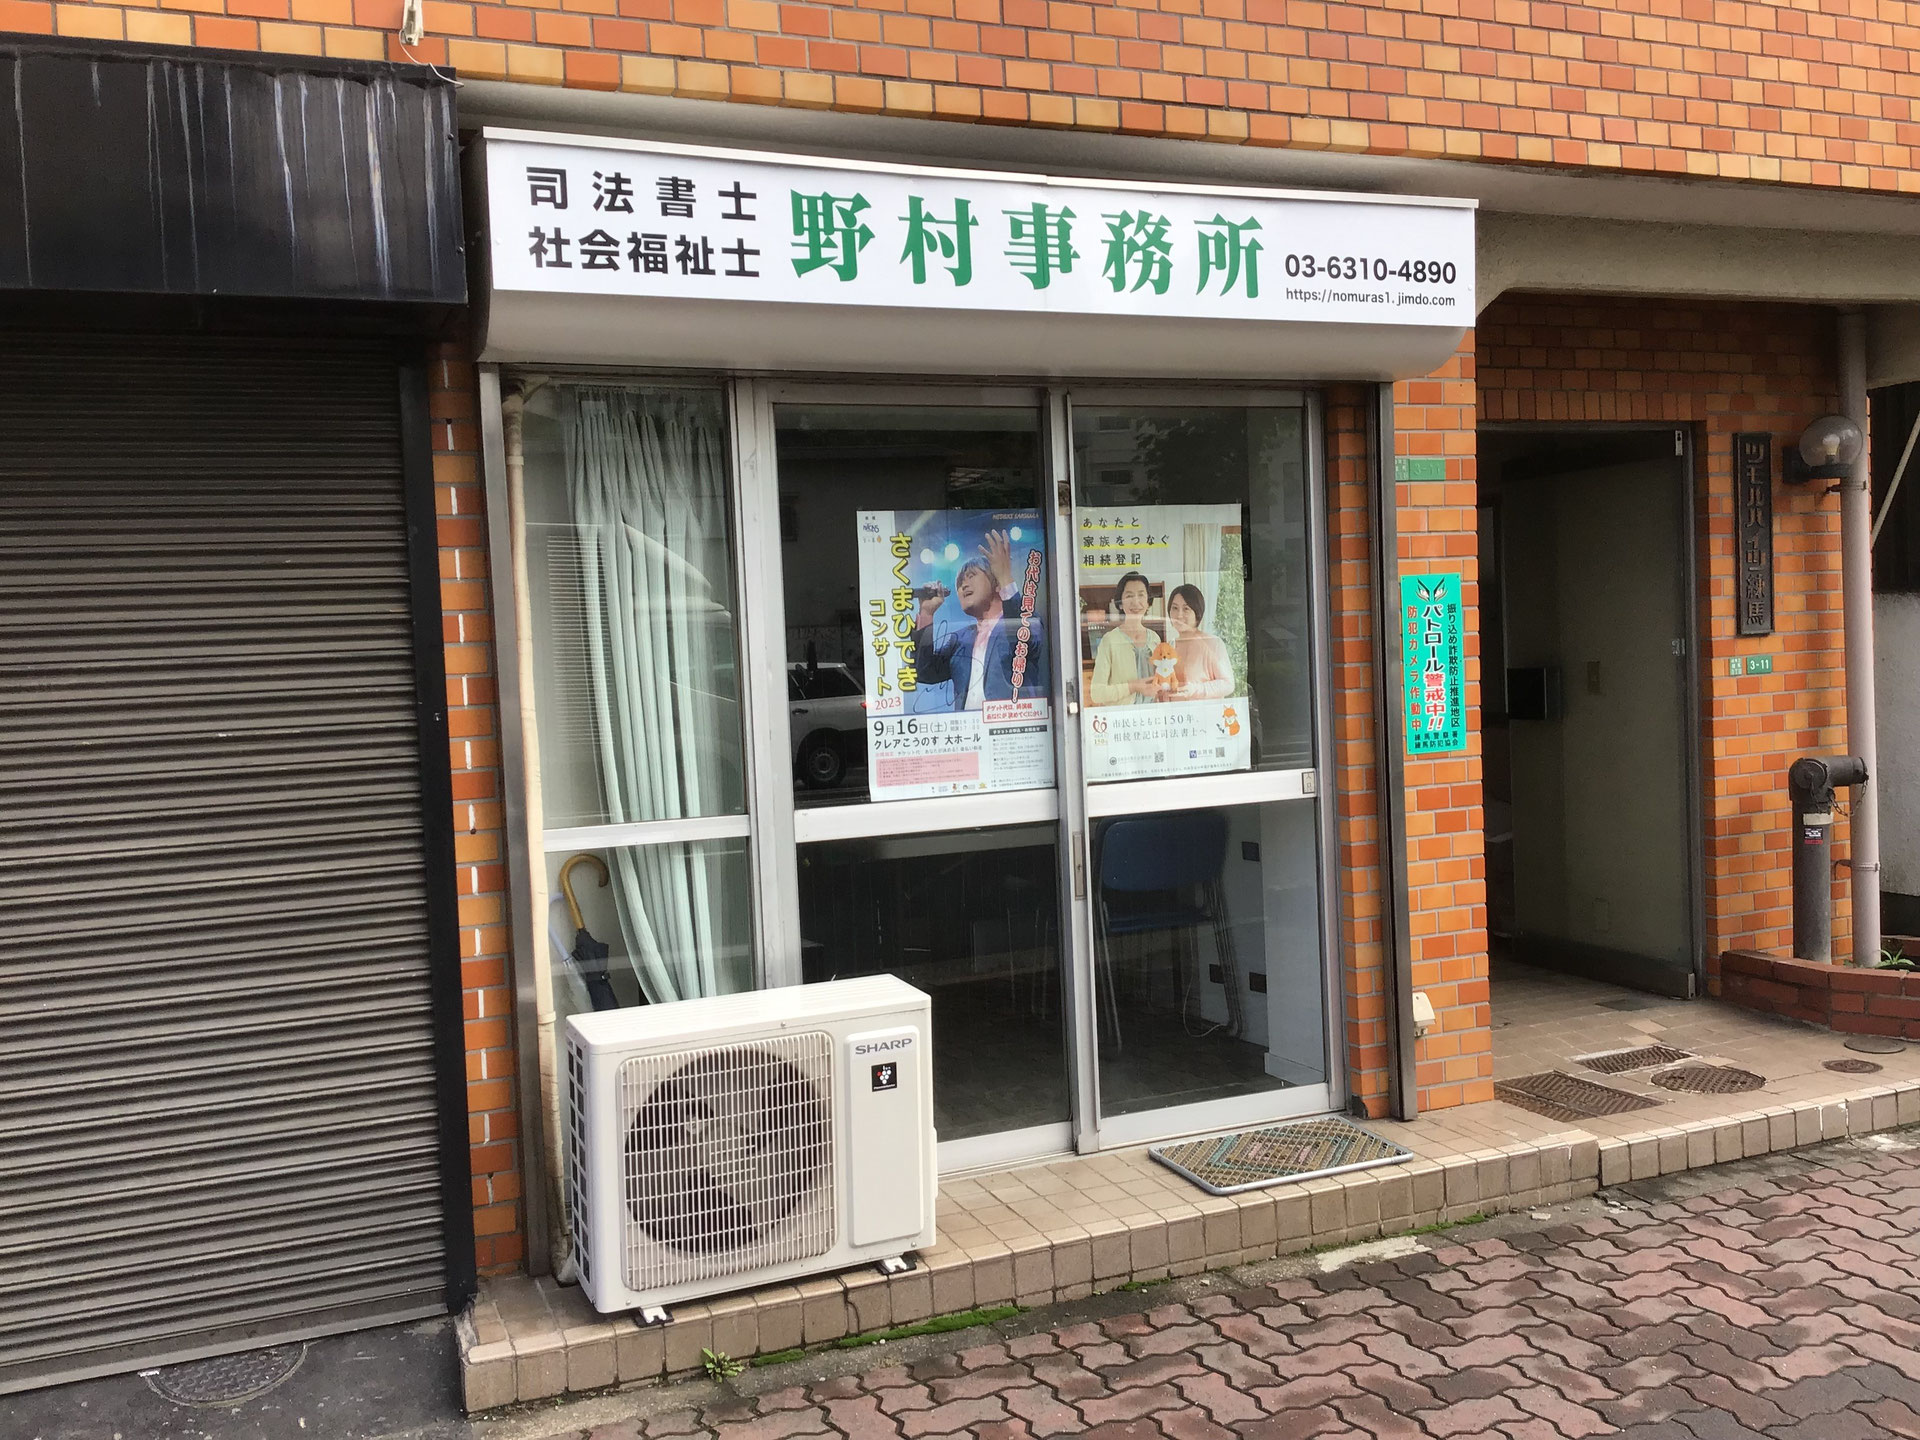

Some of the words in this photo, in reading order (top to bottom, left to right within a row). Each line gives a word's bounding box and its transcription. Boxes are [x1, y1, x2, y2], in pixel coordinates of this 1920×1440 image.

[526, 166, 757, 222] 司法書士
[528, 226, 761, 278] 社会福祉士
[790, 188, 1264, 299] 野村事務所
[1285, 254, 1456, 284] 03-6310-4890
[1286, 288, 1456, 307] https://nomuras1.jimdo.com
[1083, 517, 1140, 528] あなたと
[1083, 535, 1170, 547] 家族をつなぐ
[1083, 553, 1142, 566] 相続登記
[890, 532, 918, 693] さくまひでき
[869, 599, 892, 697] コンサート
[1407, 605, 1421, 731] 防犯カメラ作動中
[1422, 604, 1446, 730] パトロール警戒中!!
[1447, 603, 1460, 728] 振り込め詐欺防止推進地区
[1750, 659, 1769, 670] 3-11
[875, 697, 902, 711] 2023
[873, 718, 948, 737] 9月16日(土)
[874, 735, 939, 750] クレアこうのす
[944, 733, 981, 746] 大ホール
[855, 1038, 913, 1055] SHARP
